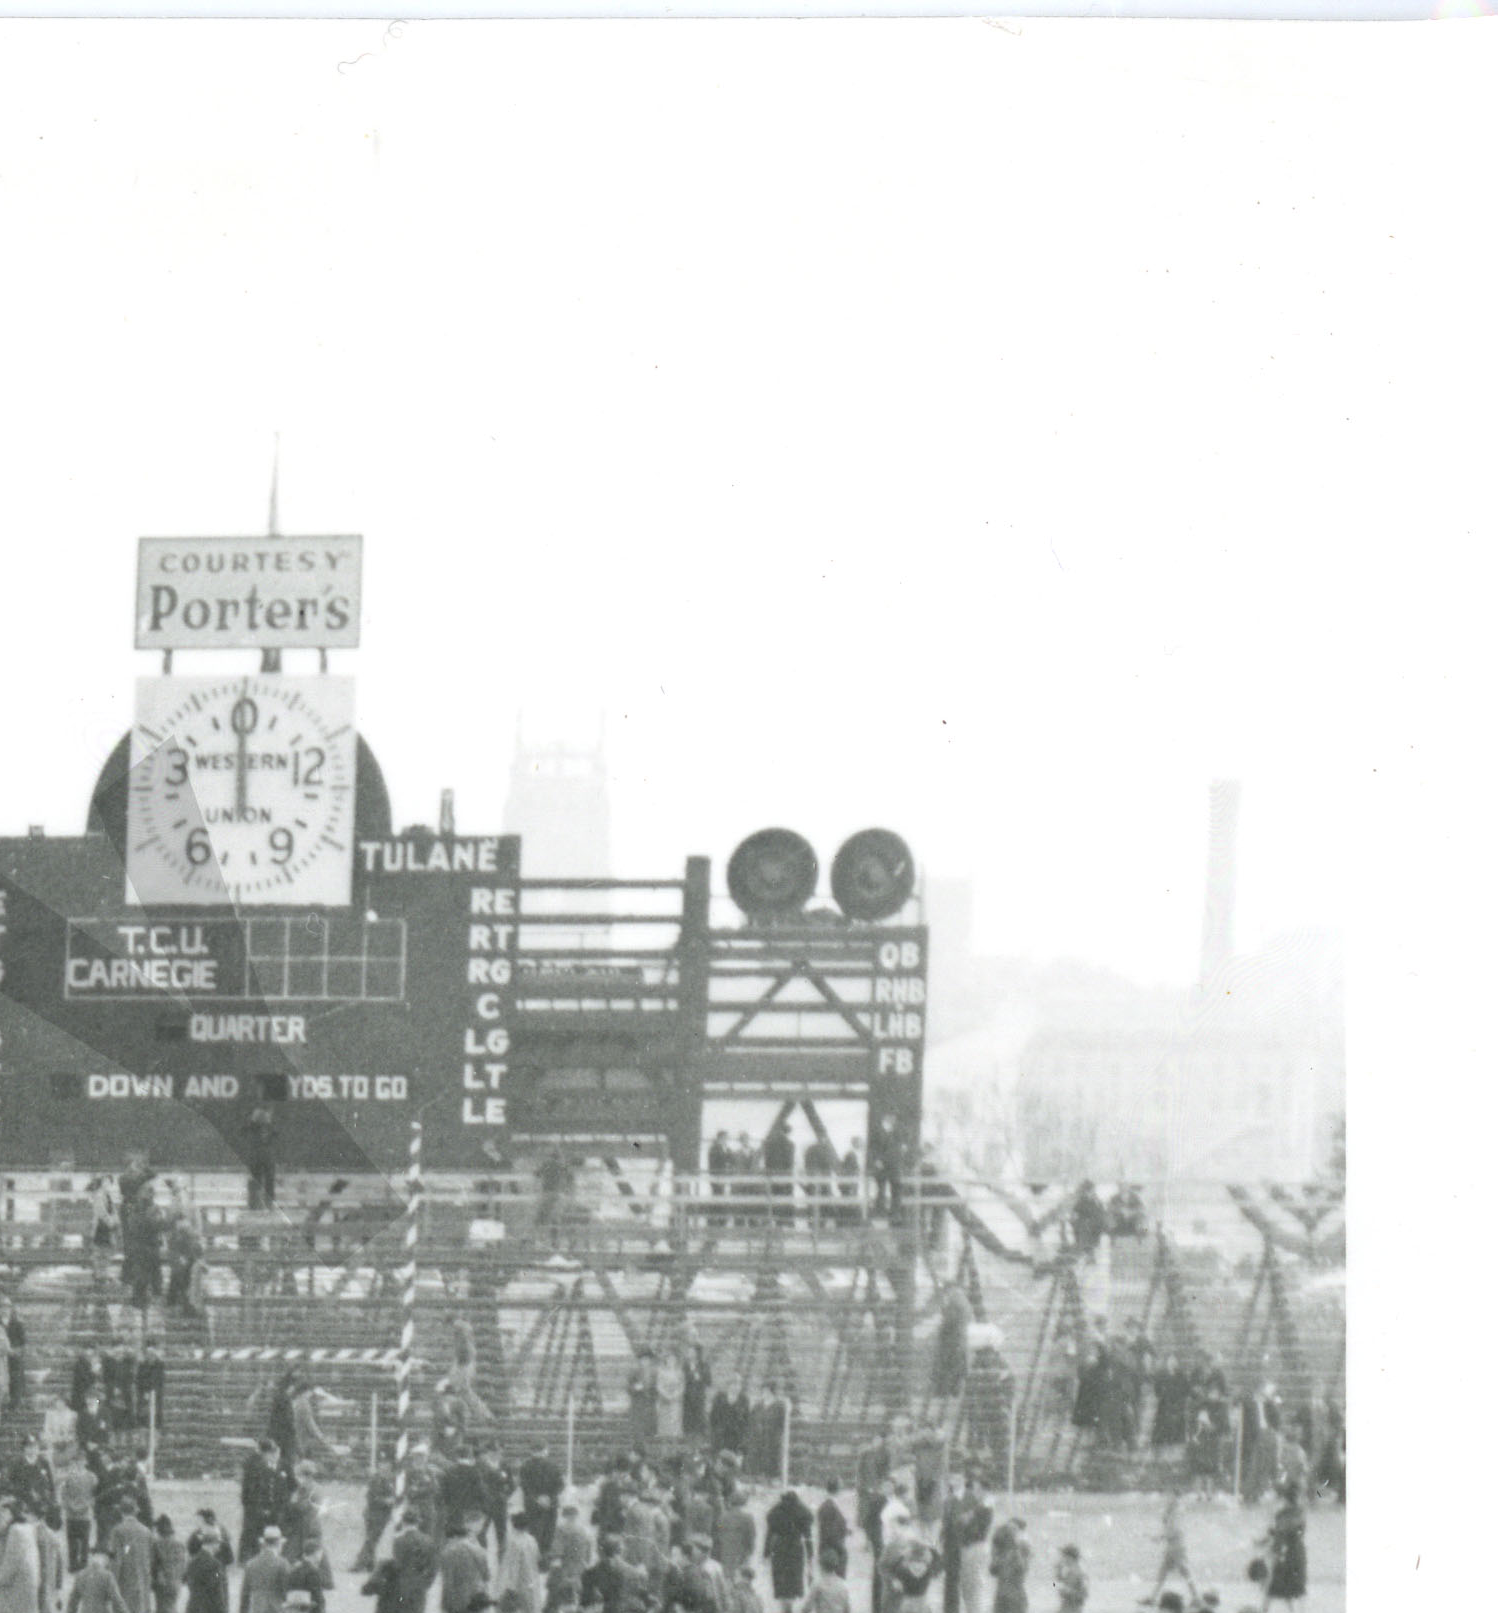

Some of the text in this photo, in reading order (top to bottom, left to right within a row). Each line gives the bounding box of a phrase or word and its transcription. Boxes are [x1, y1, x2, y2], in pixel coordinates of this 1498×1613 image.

[159, 551, 349, 574] COURTESY
[149, 584, 350, 631] Porter's
[164, 748, 189, 787] 3
[292, 747, 326, 788] 12
[185, 827, 211, 866] 6
[268, 827, 295, 865] 9
[359, 841, 499, 871] TULANE
[470, 888, 515, 915] RE
[117, 926, 209, 954] T.C.U.
[469, 923, 514, 950] RT
[879, 941, 920, 970] QB
[67, 960, 219, 989] CARNEGIE
[468, 957, 511, 984] RG
[477, 993, 500, 1019] C
[190, 1015, 306, 1043] QUARTER
[873, 1012, 922, 1038] LHB
[465, 1028, 510, 1055] LG
[879, 1048, 913, 1074] FB
[88, 1075, 173, 1099] DOWN
[185, 1075, 239, 1098] AND
[375, 1075, 407, 1099] GO
[464, 1063, 508, 1089] LT
[463, 1097, 507, 1124] LE
